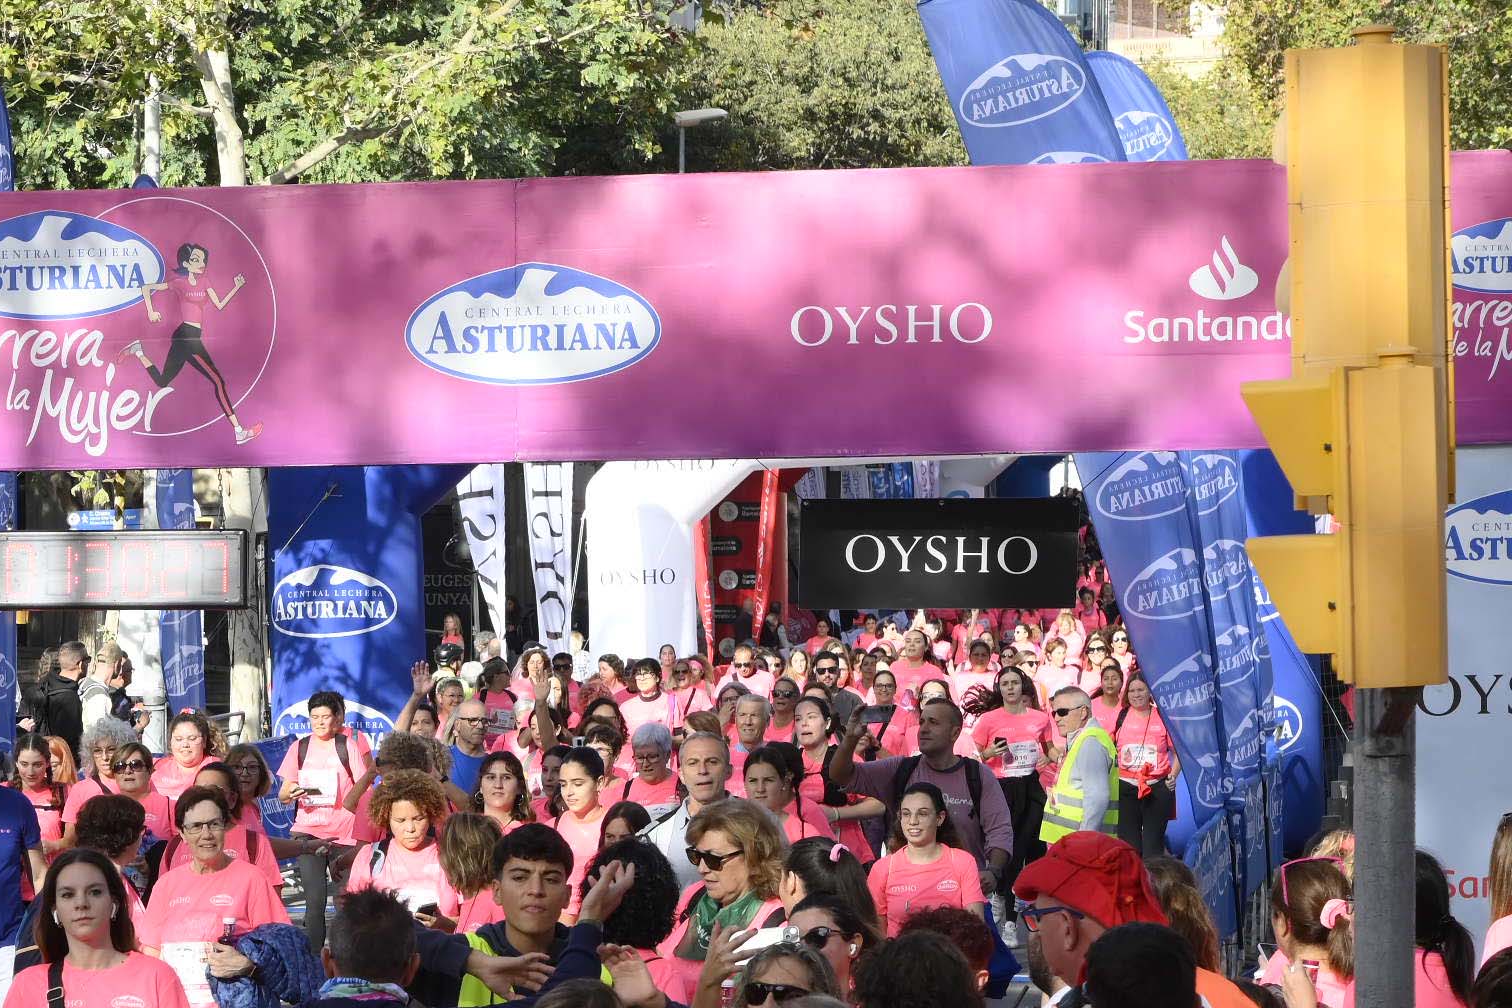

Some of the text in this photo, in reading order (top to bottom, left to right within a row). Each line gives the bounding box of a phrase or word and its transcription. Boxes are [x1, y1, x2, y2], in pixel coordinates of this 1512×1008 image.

[66, 246, 140, 259] LECHERA
[1465, 244, 1512, 252] CENTRA
[465, 303, 633, 319] CENTRAL LECHERA
[1452, 299, 1512, 328] arre
[425, 311, 641, 356] ASTURIANA
[789, 301, 994, 347] OYSHO
[1124, 310, 1291, 343] Santand
[1474, 327, 1492, 356] la
[6, 372, 30, 412] la
[26, 357, 175, 456] Mujer
[1471, 523, 1512, 533] CENT
[845, 533, 1039, 575] OYSHO
[1445, 526, 1512, 562] ASTU
[600, 568, 676, 585] OYSHO
[288, 589, 382, 599] CENTRAL LECHERA
[275, 599, 388, 621] ASTURIANA
[289, 722, 312, 730] CENT
